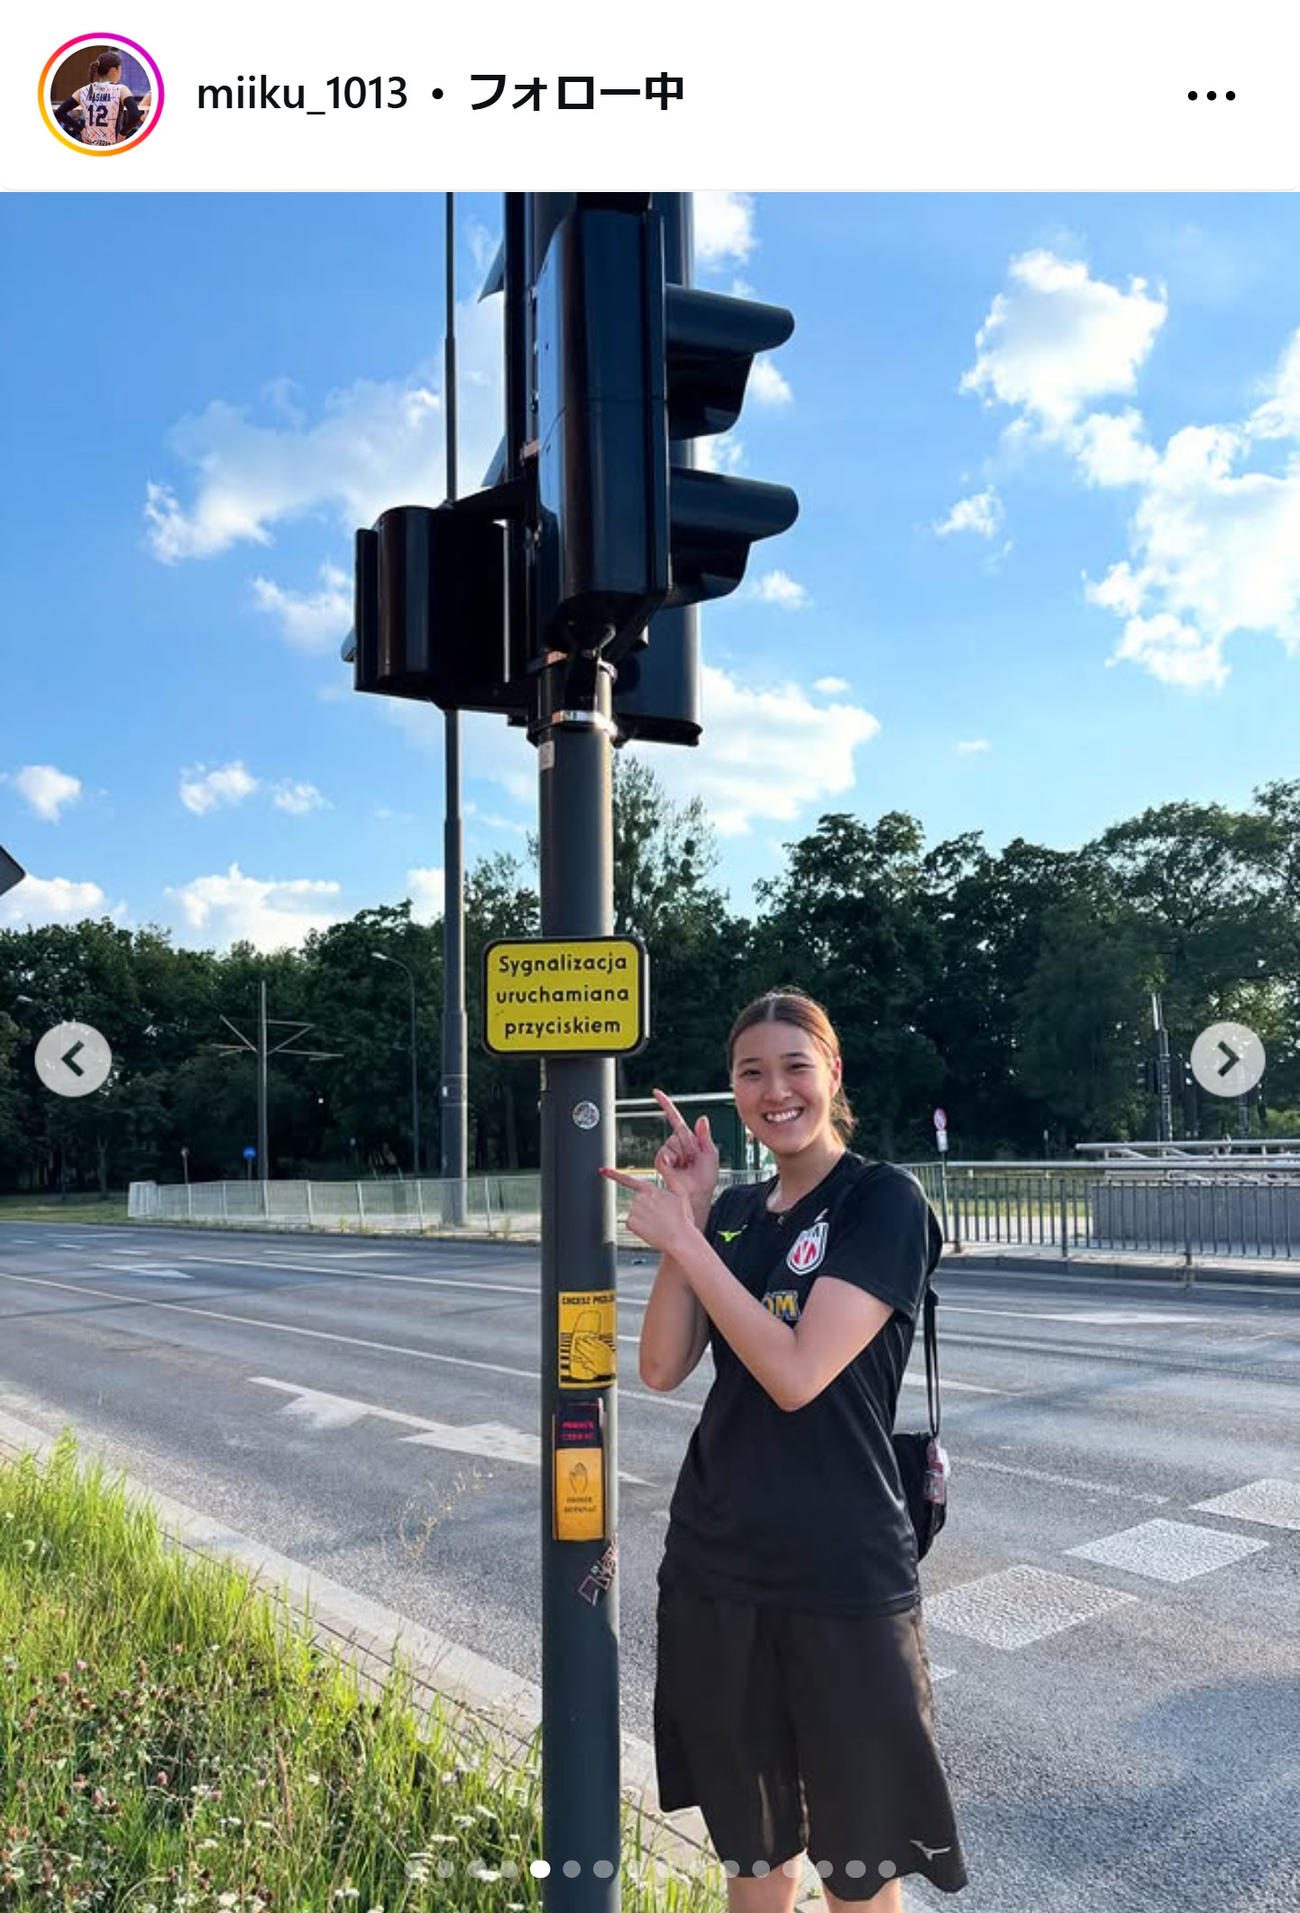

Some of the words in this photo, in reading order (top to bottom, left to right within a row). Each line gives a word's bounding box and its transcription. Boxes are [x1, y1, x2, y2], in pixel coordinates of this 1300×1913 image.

[88, 104, 108, 127] 12
[498, 952, 627, 978] Sygnalizacja
[496, 985, 629, 1004] uruchamiana
[504, 1016, 621, 1039] przyciskiem
